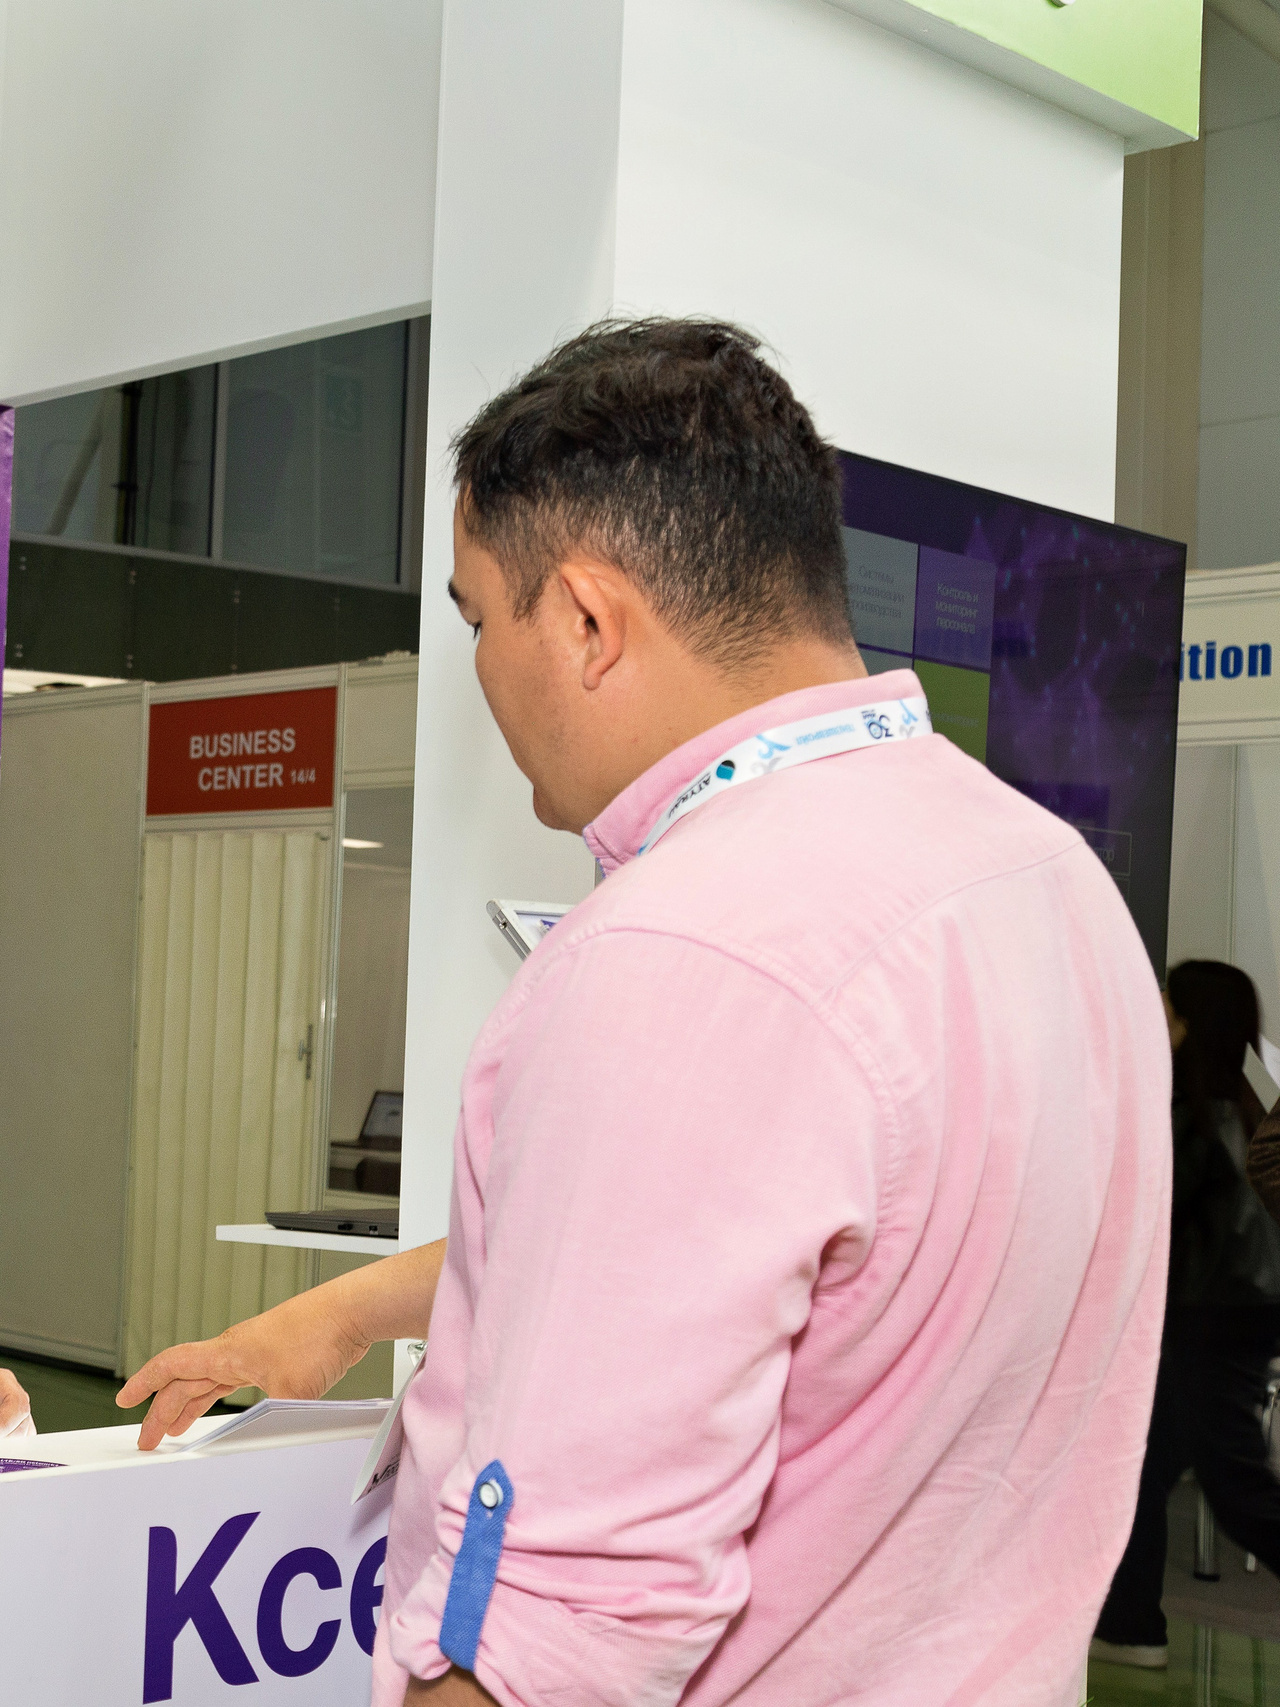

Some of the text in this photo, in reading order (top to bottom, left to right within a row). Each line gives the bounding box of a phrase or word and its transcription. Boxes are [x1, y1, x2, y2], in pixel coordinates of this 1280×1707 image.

[189, 727, 296, 760] BUSINESS
[198, 763, 317, 792] CENTER 14/4
